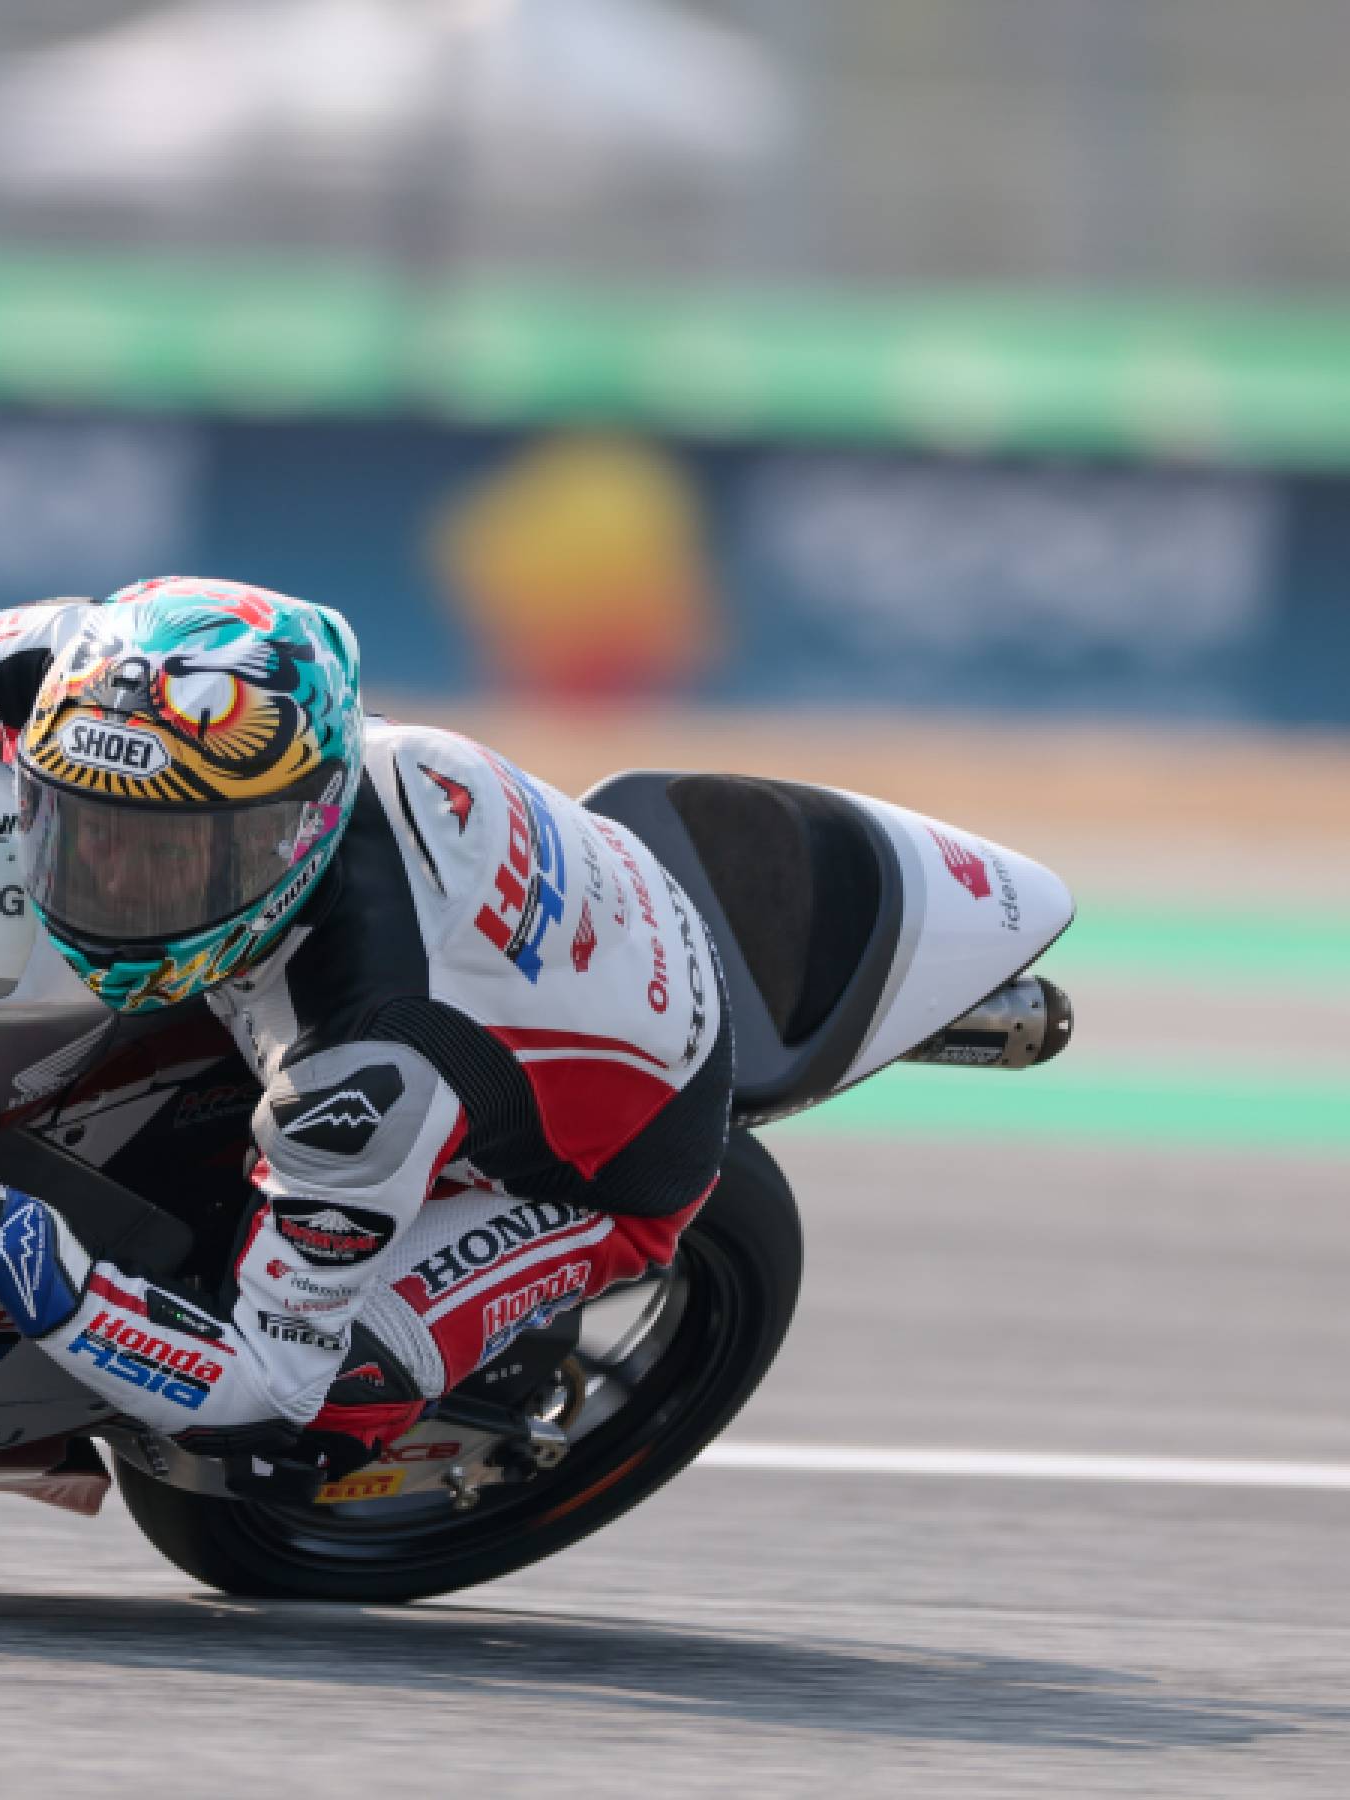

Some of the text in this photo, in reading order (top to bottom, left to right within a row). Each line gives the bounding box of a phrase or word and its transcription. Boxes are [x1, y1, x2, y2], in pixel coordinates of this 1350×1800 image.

[70, 724, 152, 769] SHOEI
[483, 1260, 592, 1338] Honda
[66, 1332, 210, 1411] Asia
[89, 1311, 224, 1383] Honda
